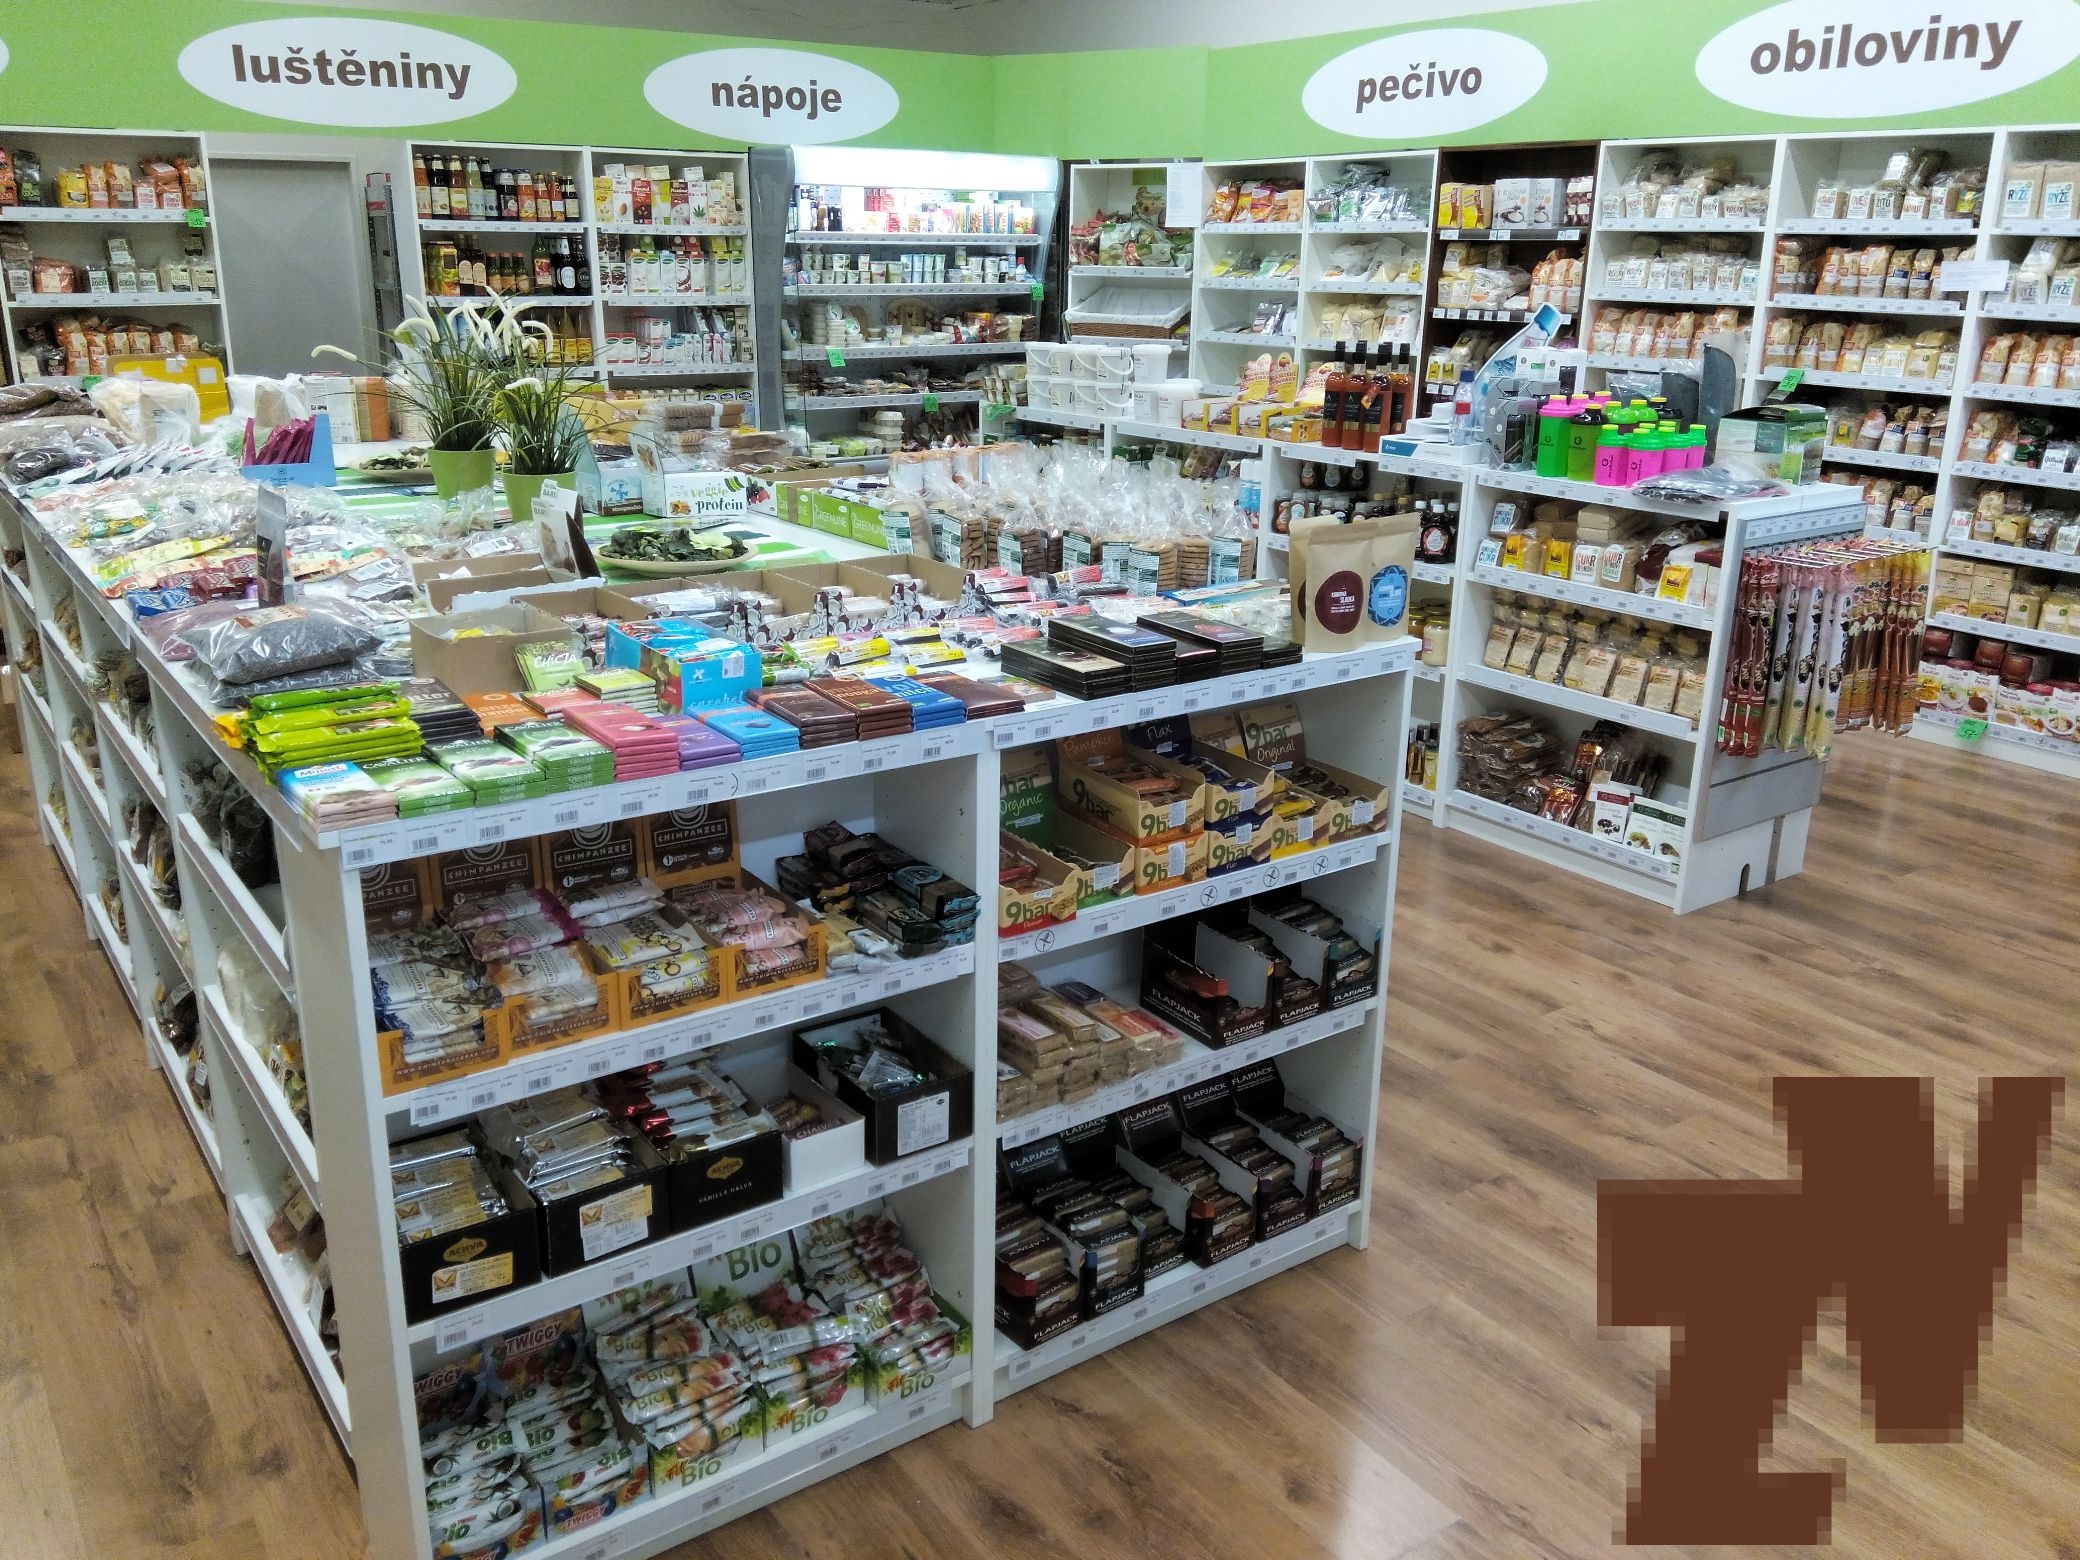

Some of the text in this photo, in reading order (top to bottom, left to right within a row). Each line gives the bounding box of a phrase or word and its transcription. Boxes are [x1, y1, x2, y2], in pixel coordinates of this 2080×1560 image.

[1750, 15, 2022, 75] obiloviny
[232, 44, 472, 100] luštěniny
[711, 76, 842, 120] nápoje
[1355, 61, 1483, 113] pečivo
[691, 482, 728, 498] veggie
[696, 499, 743, 513] protein
[1147, 724, 1173, 740] Flax
[1245, 722, 1291, 748] 9bar
[432, 738, 492, 752] CAVALIER
[1064, 734, 1116, 755] Pumpkin
[1257, 741, 1297, 763] Original
[362, 757, 428, 770] CAVALIER
[1000, 773, 1040, 796] bar
[658, 825, 724, 844] CHIMPANZEE
[557, 845, 628, 864] CHIMPANZEE
[447, 859, 524, 880] CHIMPANZEE
[1006, 900, 1050, 926] 9bar
[1334, 985, 1373, 1002] FLAPJACK
[1152, 989, 1202, 1023] FLAPJACK
[1280, 1002, 1321, 1020] FLAPJACK
[1223, 1020, 1266, 1038] FLAPJACK
[1232, 1066, 1275, 1086] FLAPJACK
[1183, 1082, 1228, 1102] FLAPJACK
[1124, 1100, 1172, 1125] FLAPJACK
[1009, 1145, 1060, 1169] FLAPJACK
[699, 1181, 753, 1204] VANILLA HALVA
[1319, 1190, 1356, 1210] FLAPJACK
[1267, 1212, 1306, 1233] FLAPJACK
[1210, 1236, 1250, 1259] FLAPJACK
[1095, 1285, 1139, 1311] FLAPJACK
[504, 1321, 563, 1353] TWIGGY
[1034, 1312, 1080, 1340] FLAPJACK
[413, 1366, 464, 1394] WIGGY
[564, 1504, 607, 1531] TWIGGY
